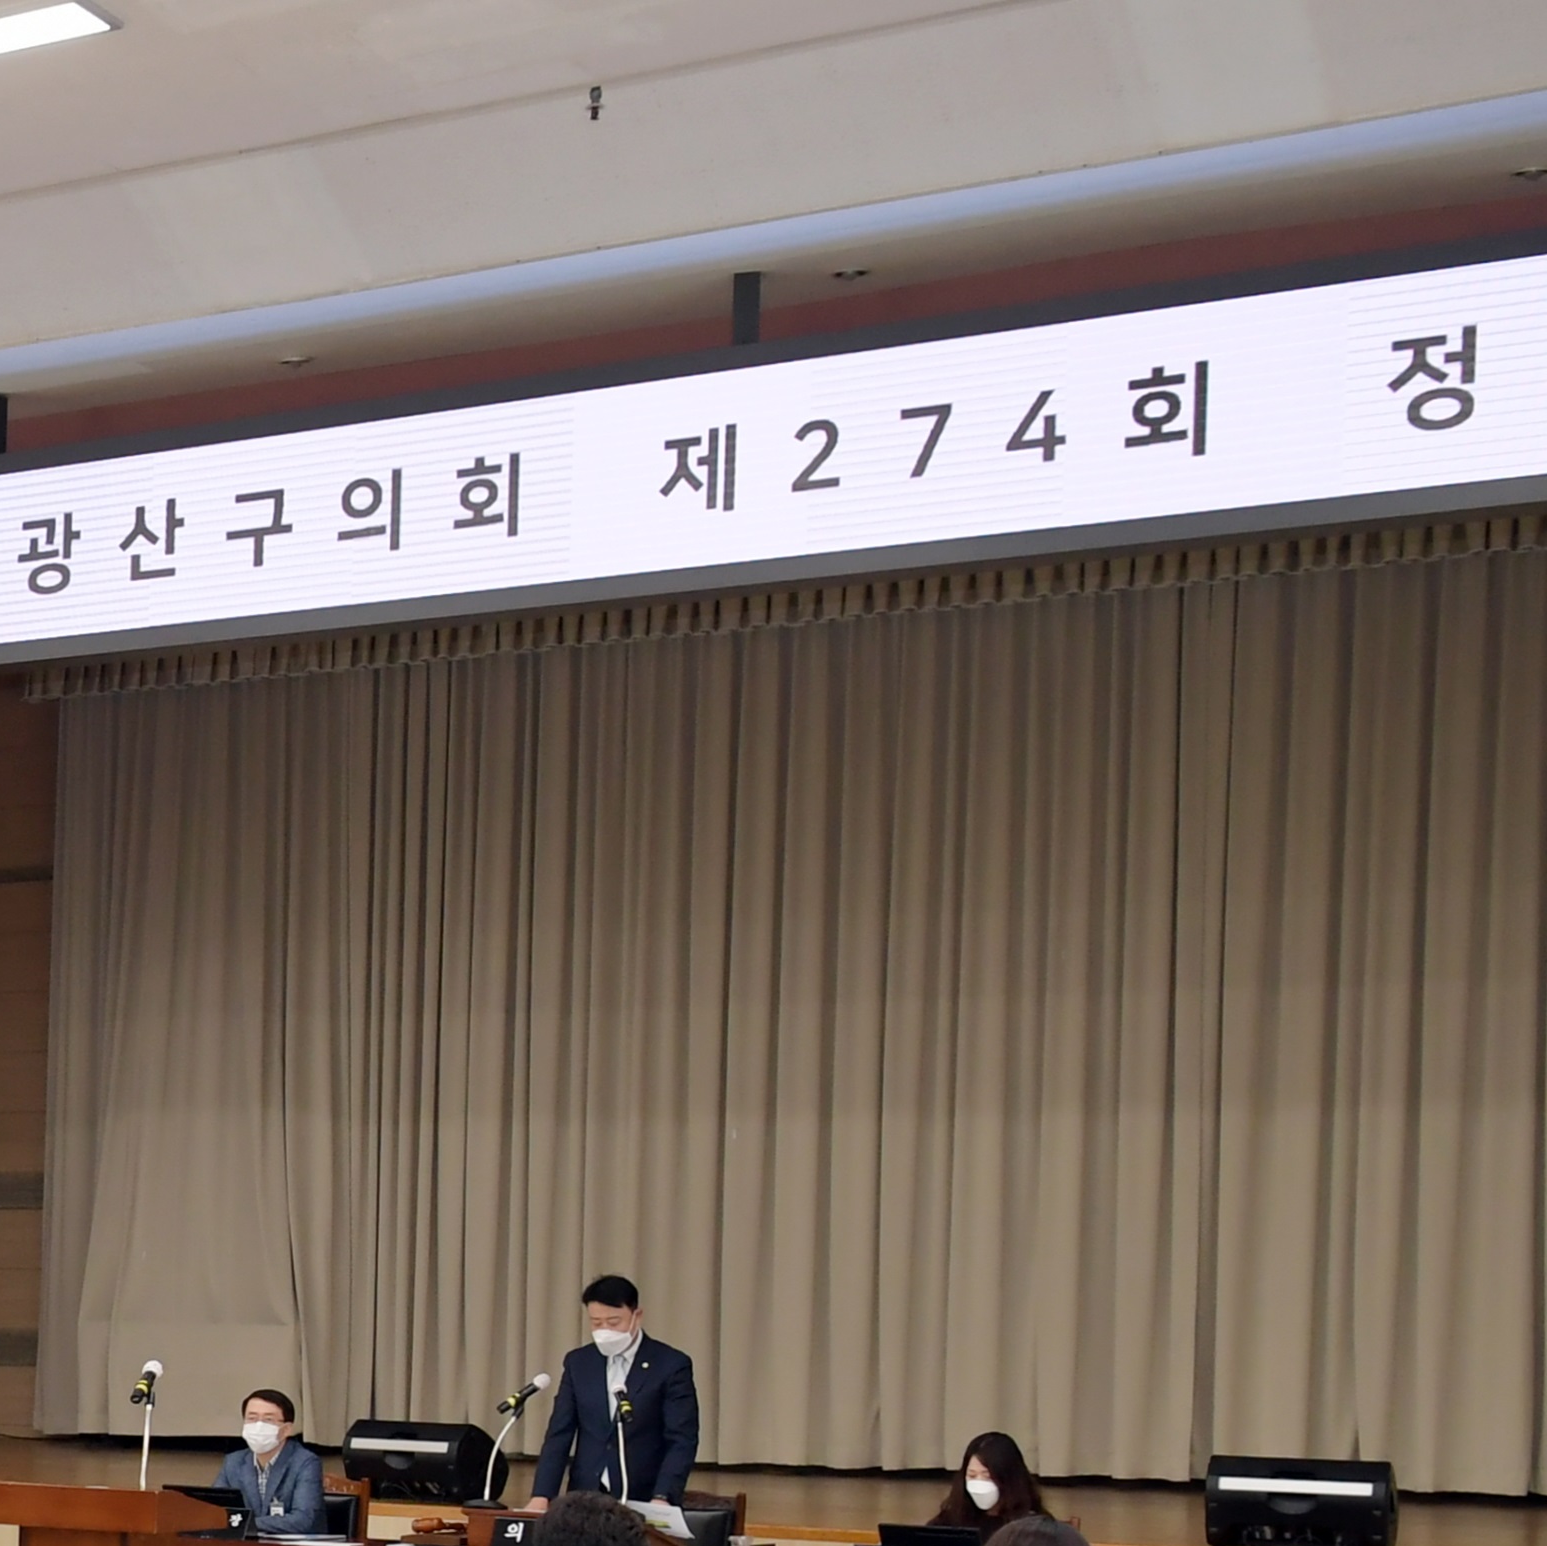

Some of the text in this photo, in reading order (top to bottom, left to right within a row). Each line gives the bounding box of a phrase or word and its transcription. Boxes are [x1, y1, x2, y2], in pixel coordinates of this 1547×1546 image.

[16, 324, 1478, 597] 광산구의회 제274회 정
